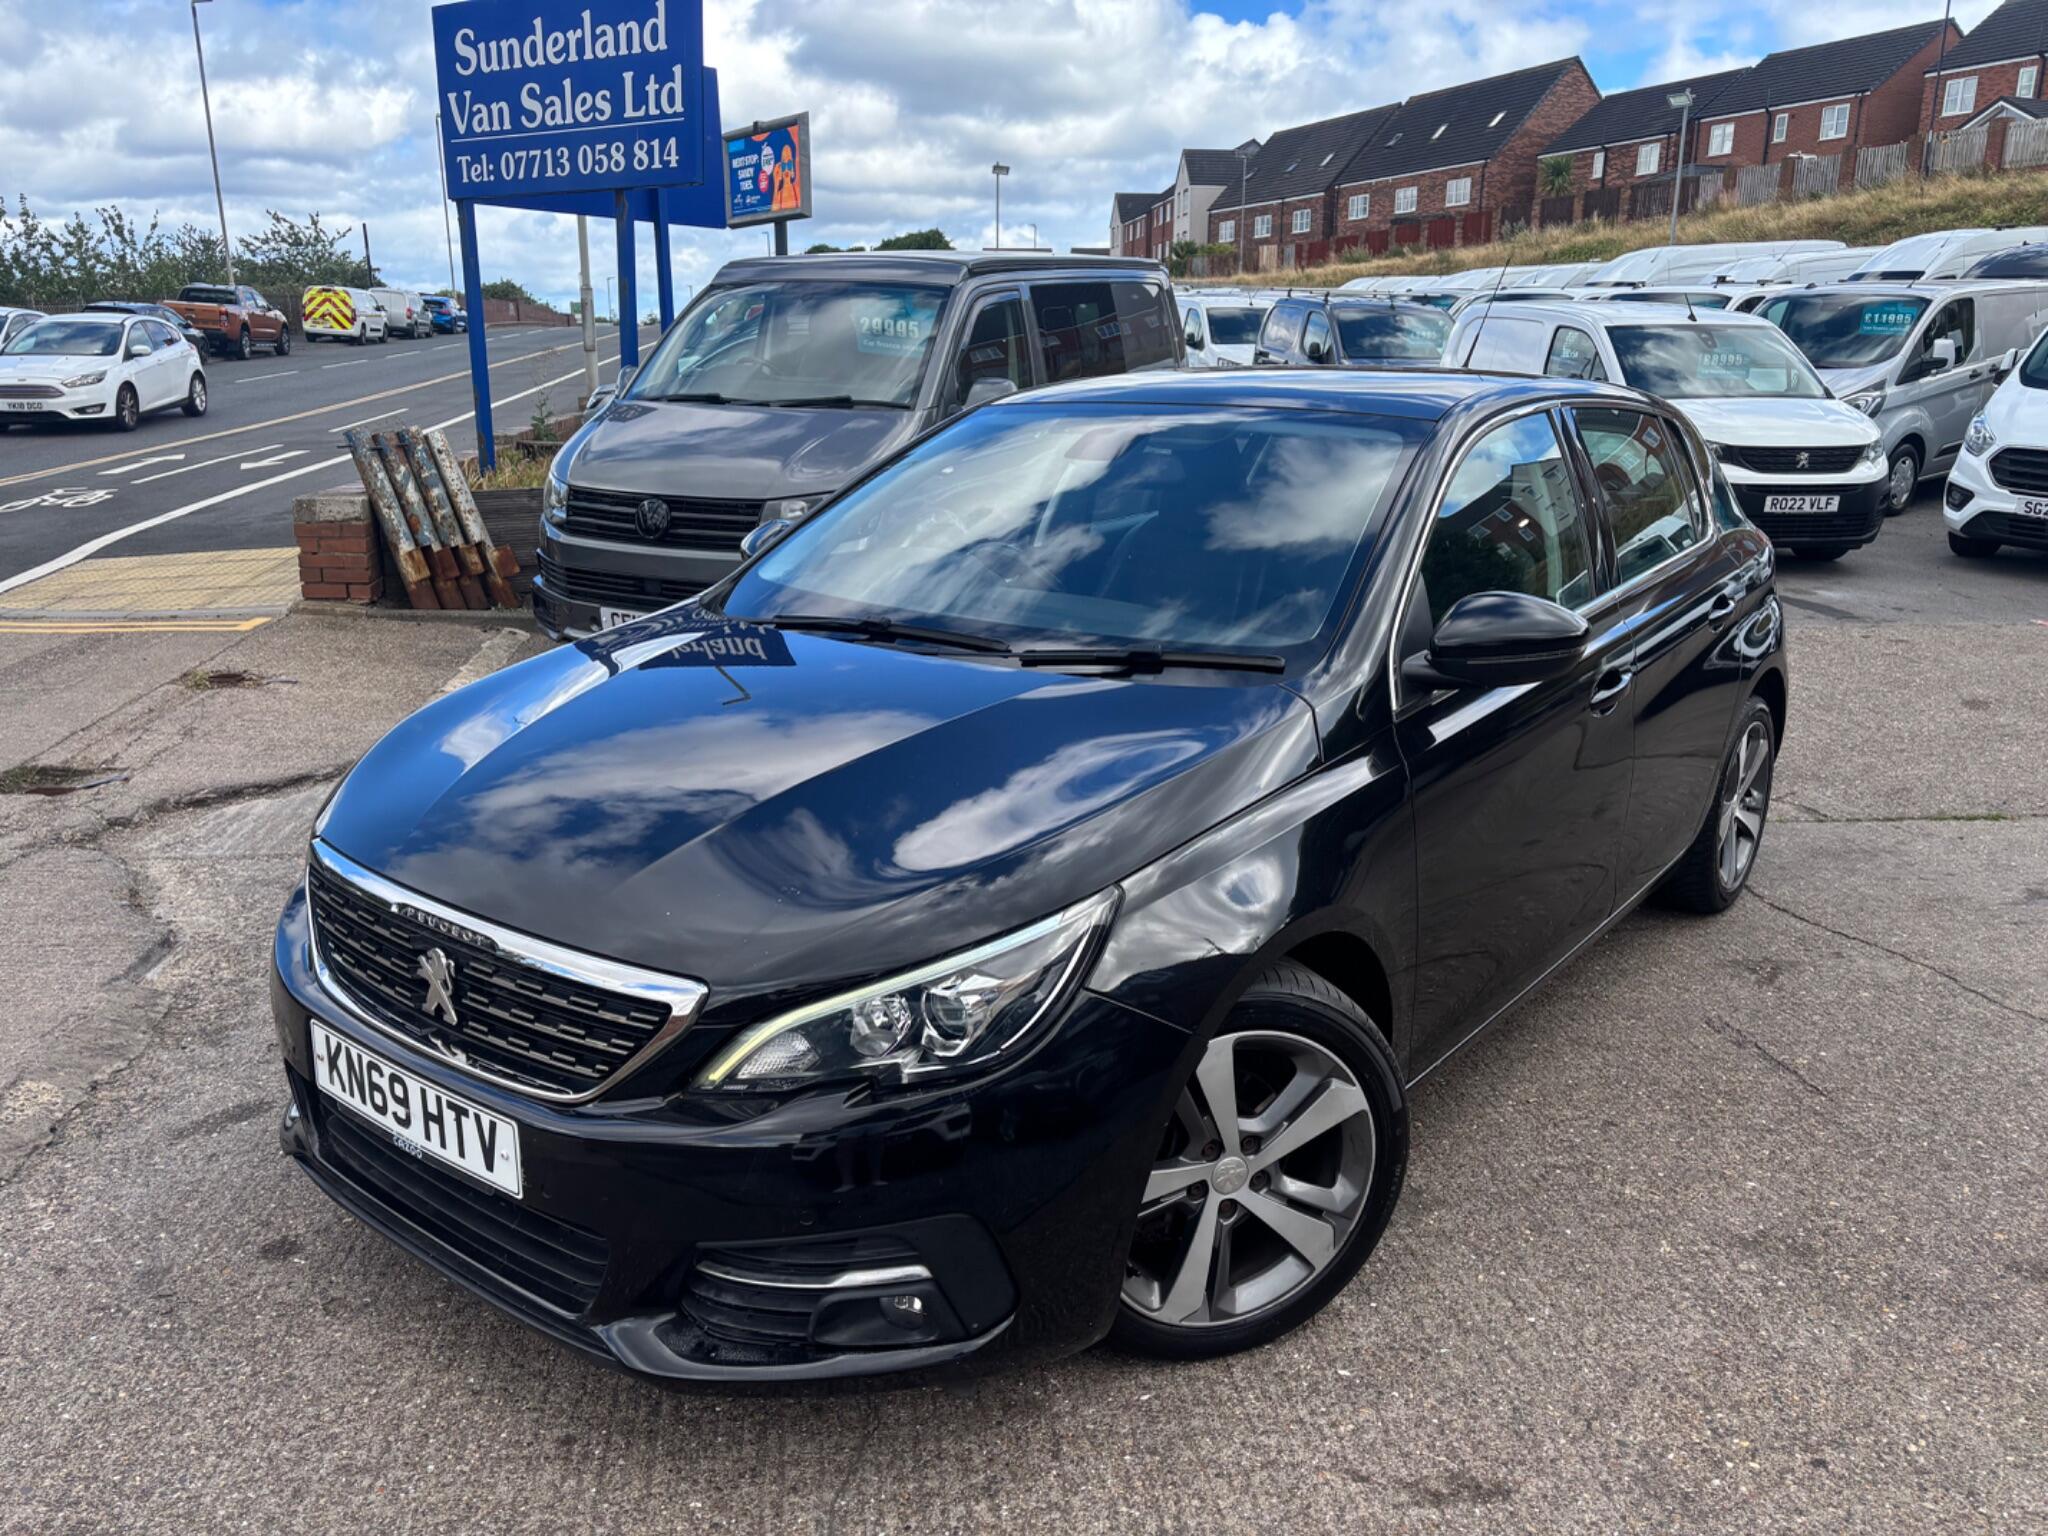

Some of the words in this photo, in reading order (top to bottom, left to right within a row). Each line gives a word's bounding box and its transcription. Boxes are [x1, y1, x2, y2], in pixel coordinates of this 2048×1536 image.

[454, 0, 667, 76] Sunderland
[447, 90, 512, 135] Van
[520, 77, 612, 129] Sales
[622, 64, 684, 118] Ltd
[457, 153, 495, 183] Tel:
[500, 146, 571, 181] 07713
[577, 141, 625, 175] 058
[633, 136, 679, 170] 814
[1770, 497, 1806, 511] RO22
[1809, 497, 1835, 510] VLF
[406, 907, 485, 945] PEUGEOT
[325, 1034, 412, 1130] KN69
[420, 1085, 497, 1174] HTV
